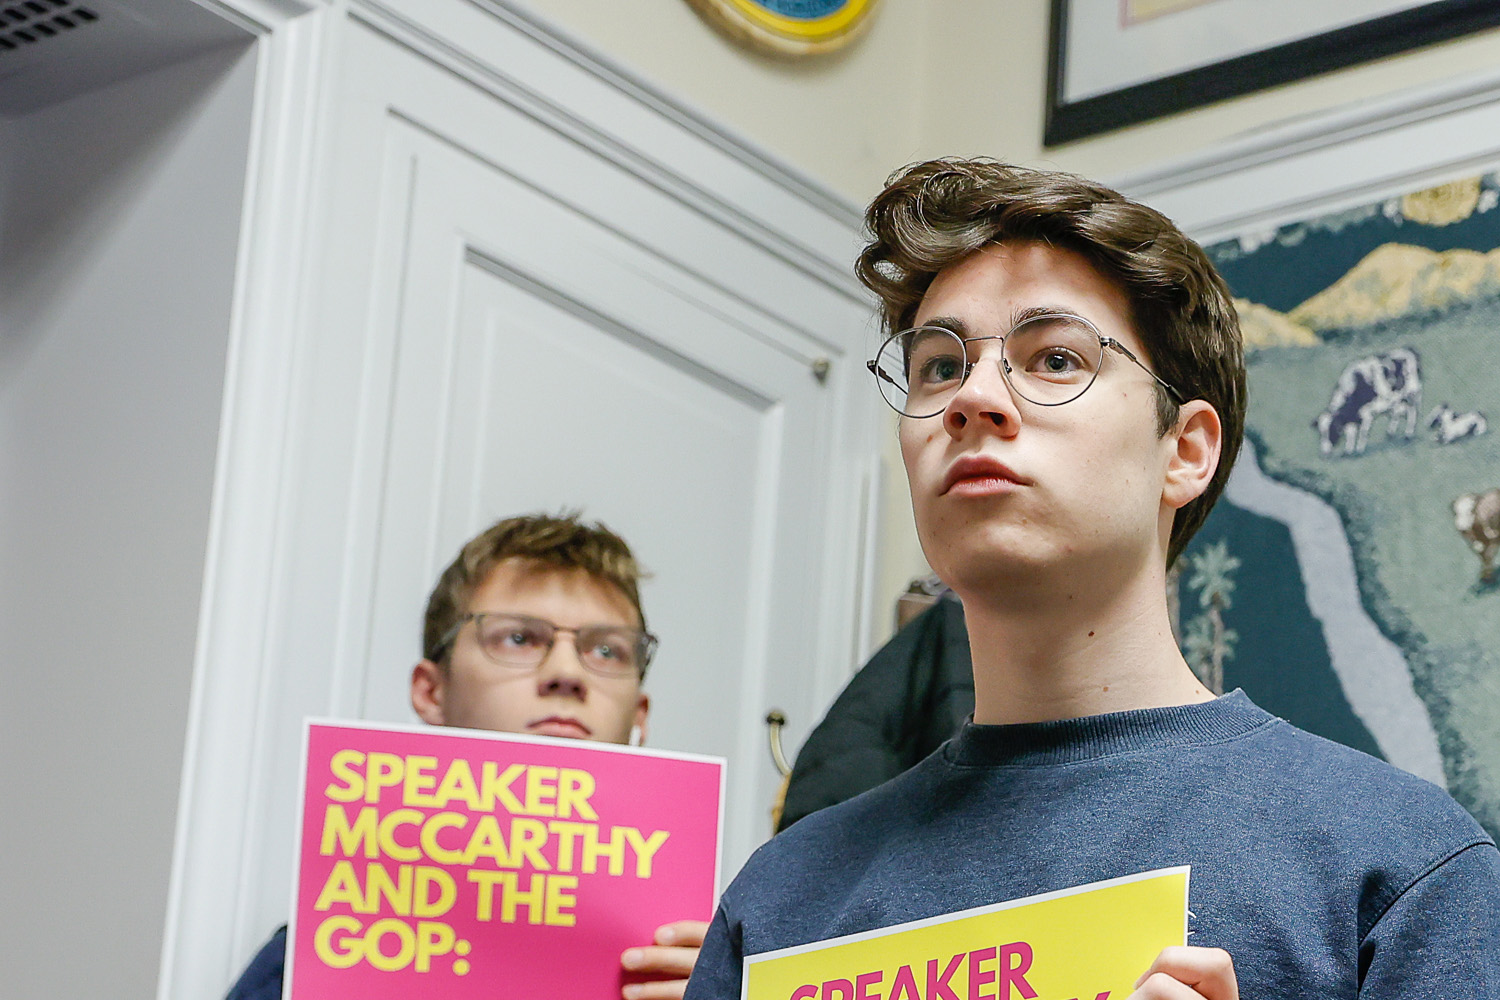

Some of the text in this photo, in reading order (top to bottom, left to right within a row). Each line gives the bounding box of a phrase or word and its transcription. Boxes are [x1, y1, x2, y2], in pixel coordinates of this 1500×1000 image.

[326, 750, 598, 820] SPEAKER
[320, 805, 670, 878] MCCARTHY
[314, 861, 578, 926] AND THE
[314, 916, 471, 975] GOP:
